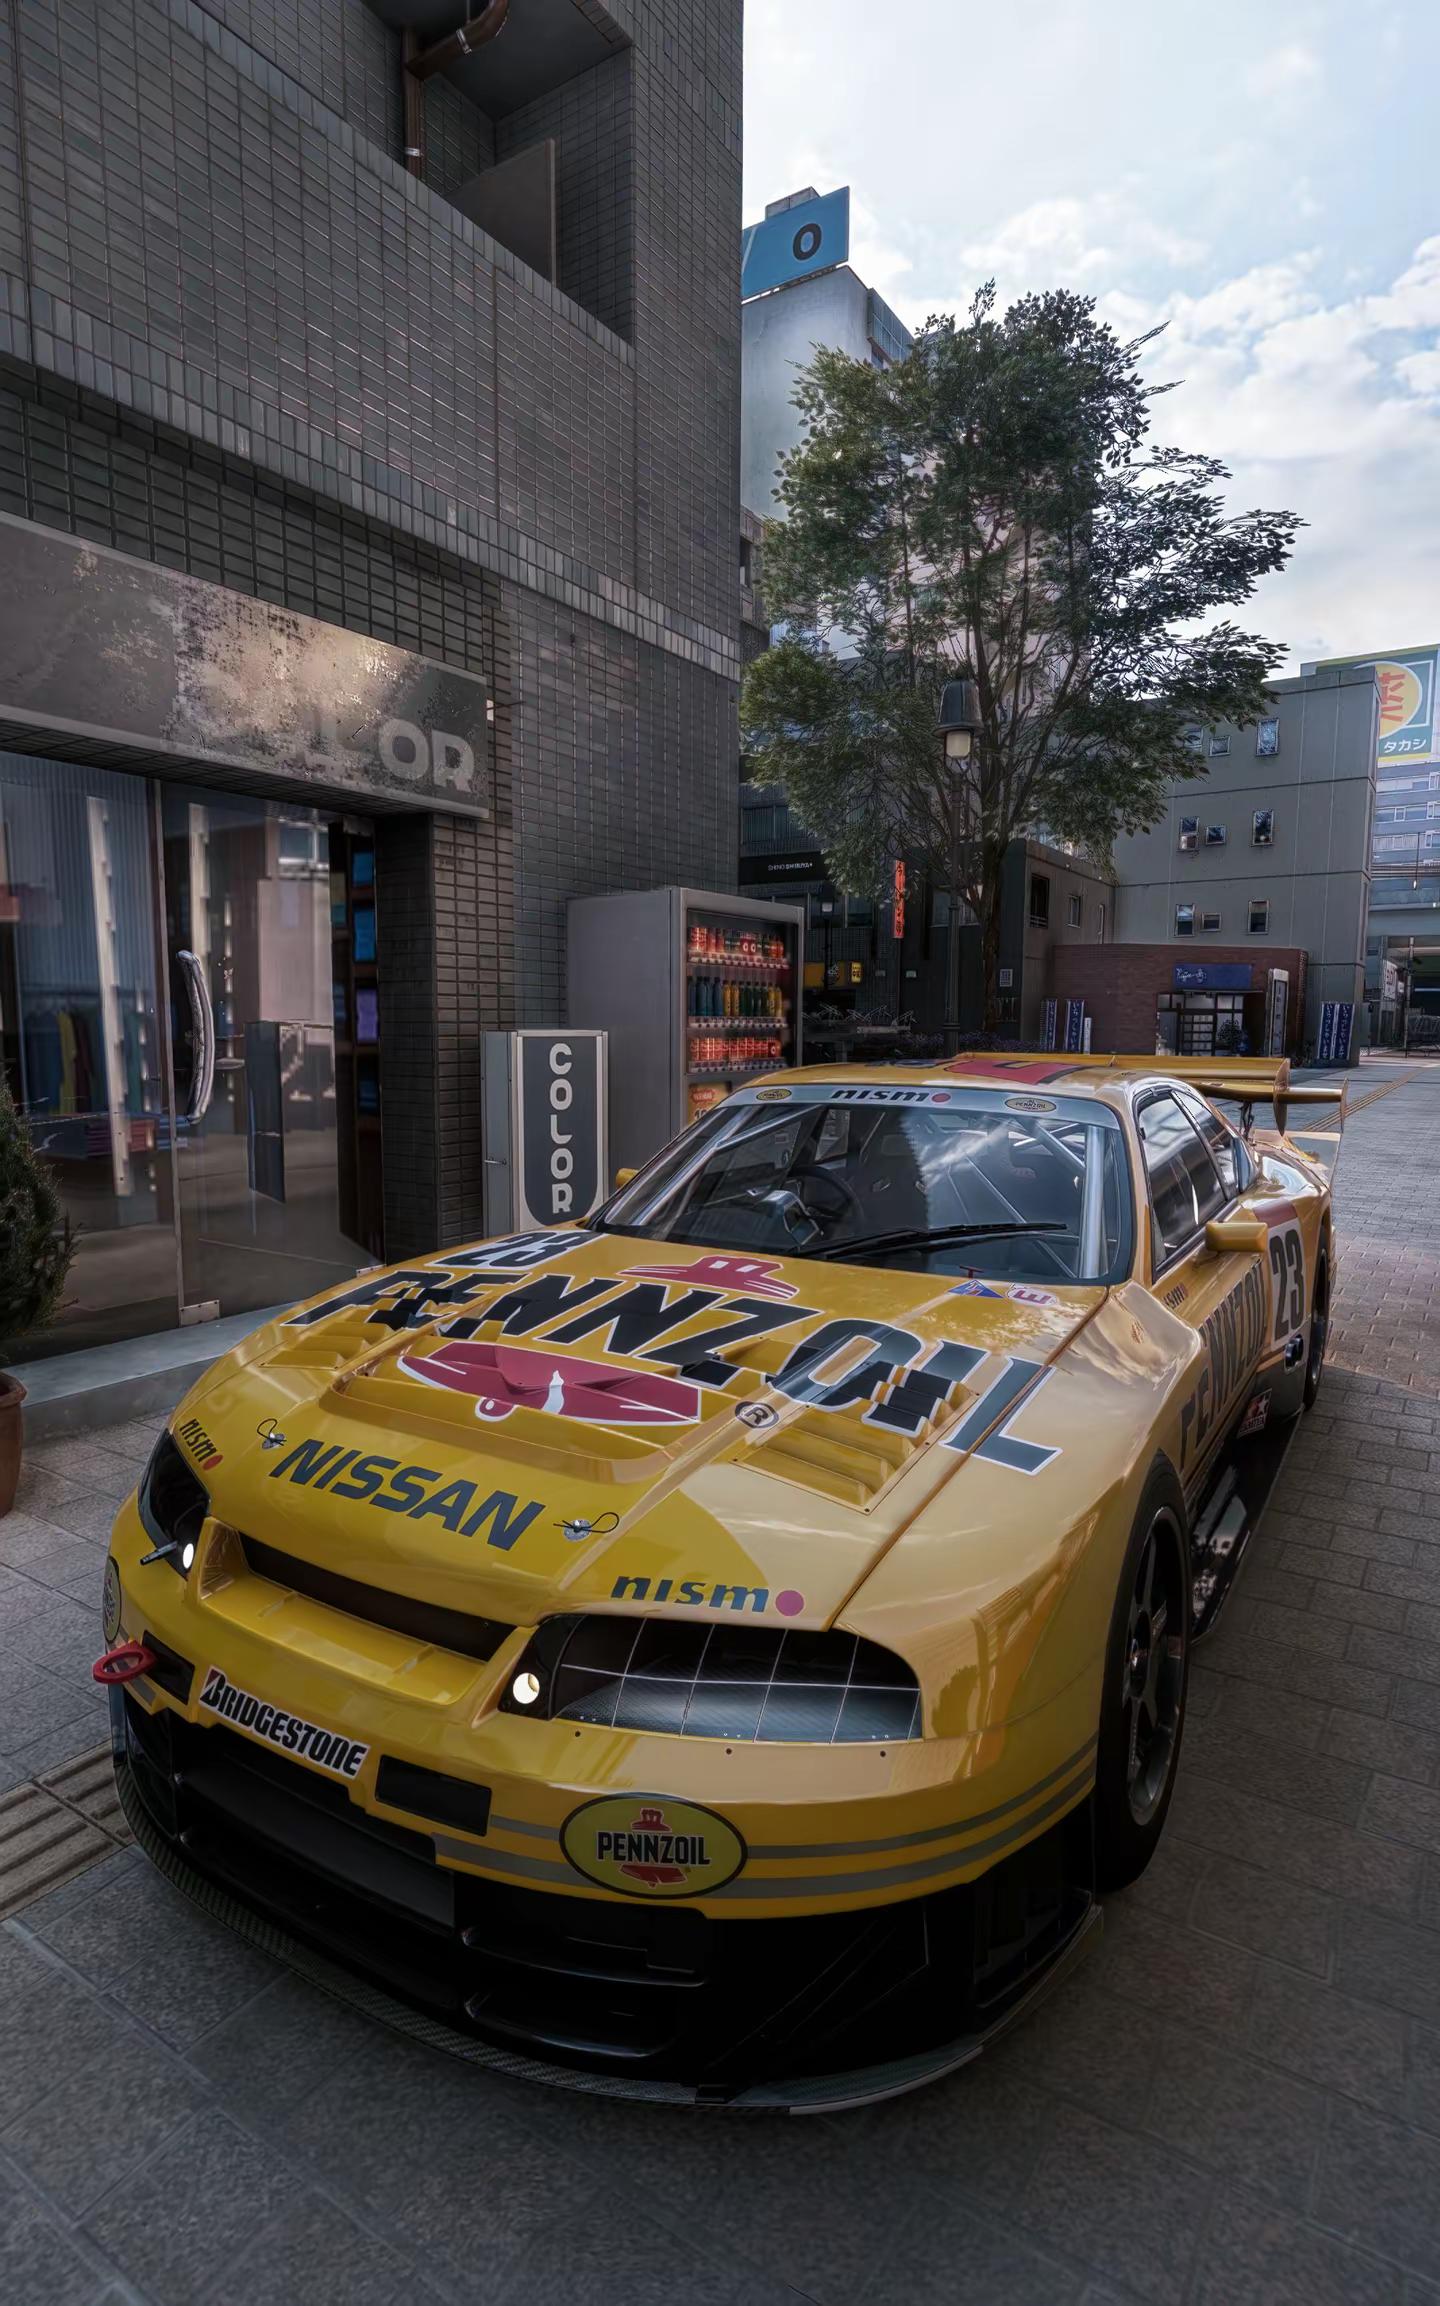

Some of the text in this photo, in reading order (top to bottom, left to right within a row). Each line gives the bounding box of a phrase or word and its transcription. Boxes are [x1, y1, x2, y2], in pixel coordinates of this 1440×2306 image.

[1384, 738, 1427, 753] タカシ
[550, 1043, 574, 1213] COLOR
[1268, 1228, 1305, 1341] 23
[279, 1270, 1064, 1476] PENNZOIL
[269, 1438, 546, 1552] NISSAN
[202, 1668, 369, 1778] BRIDGESTONE
[596, 1829, 711, 1866] PENNZOIL
